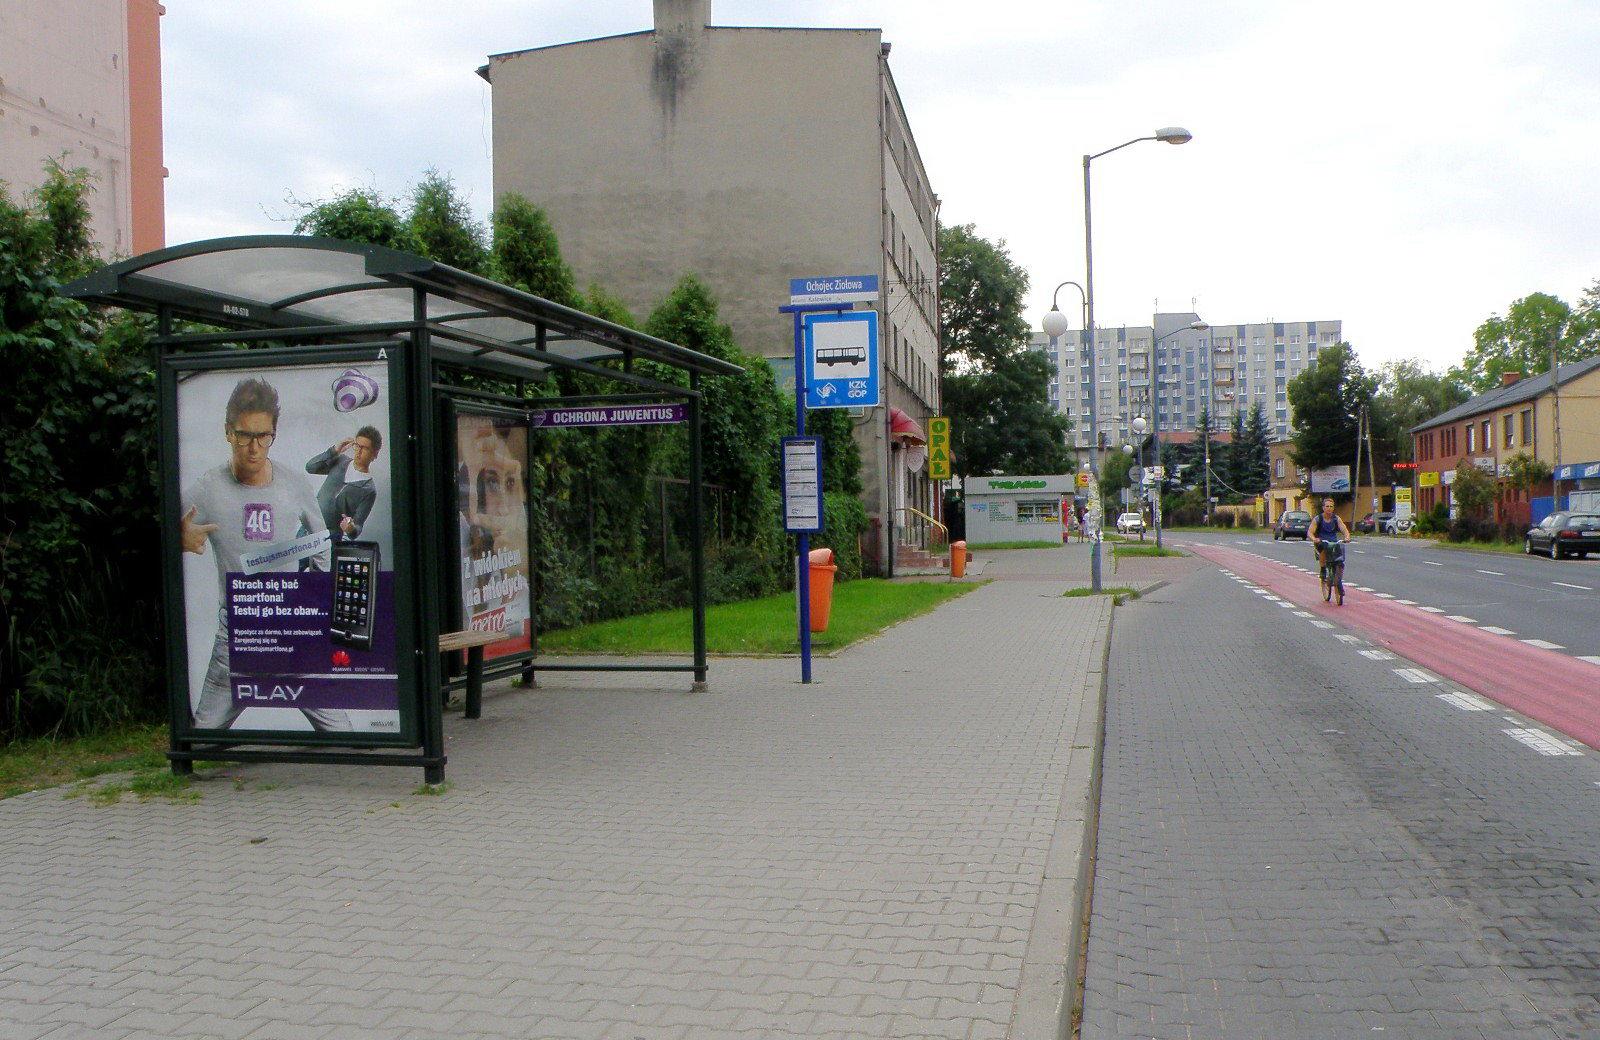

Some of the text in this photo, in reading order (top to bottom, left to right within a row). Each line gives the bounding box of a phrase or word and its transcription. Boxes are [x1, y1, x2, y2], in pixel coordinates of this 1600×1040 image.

[806, 279, 862, 292] Ochojec Ziołowa
[377, 347, 388, 359] A
[848, 380, 867, 389] KZK
[847, 390, 868, 398] GOP
[552, 408, 673, 424] OCHRONA JUWENTUS
[247, 510, 271, 533] 4G
[1397, 520, 1409, 529] K2
[246, 537, 322, 568] testujsmartfona.pl
[232, 578, 299, 591] Strach się bać
[232, 592, 284, 602] smartfona!
[233, 605, 260, 617] Testuj
[262, 607, 274, 617] go
[275, 605, 292, 616] bez
[237, 684, 304, 700] PLAY
